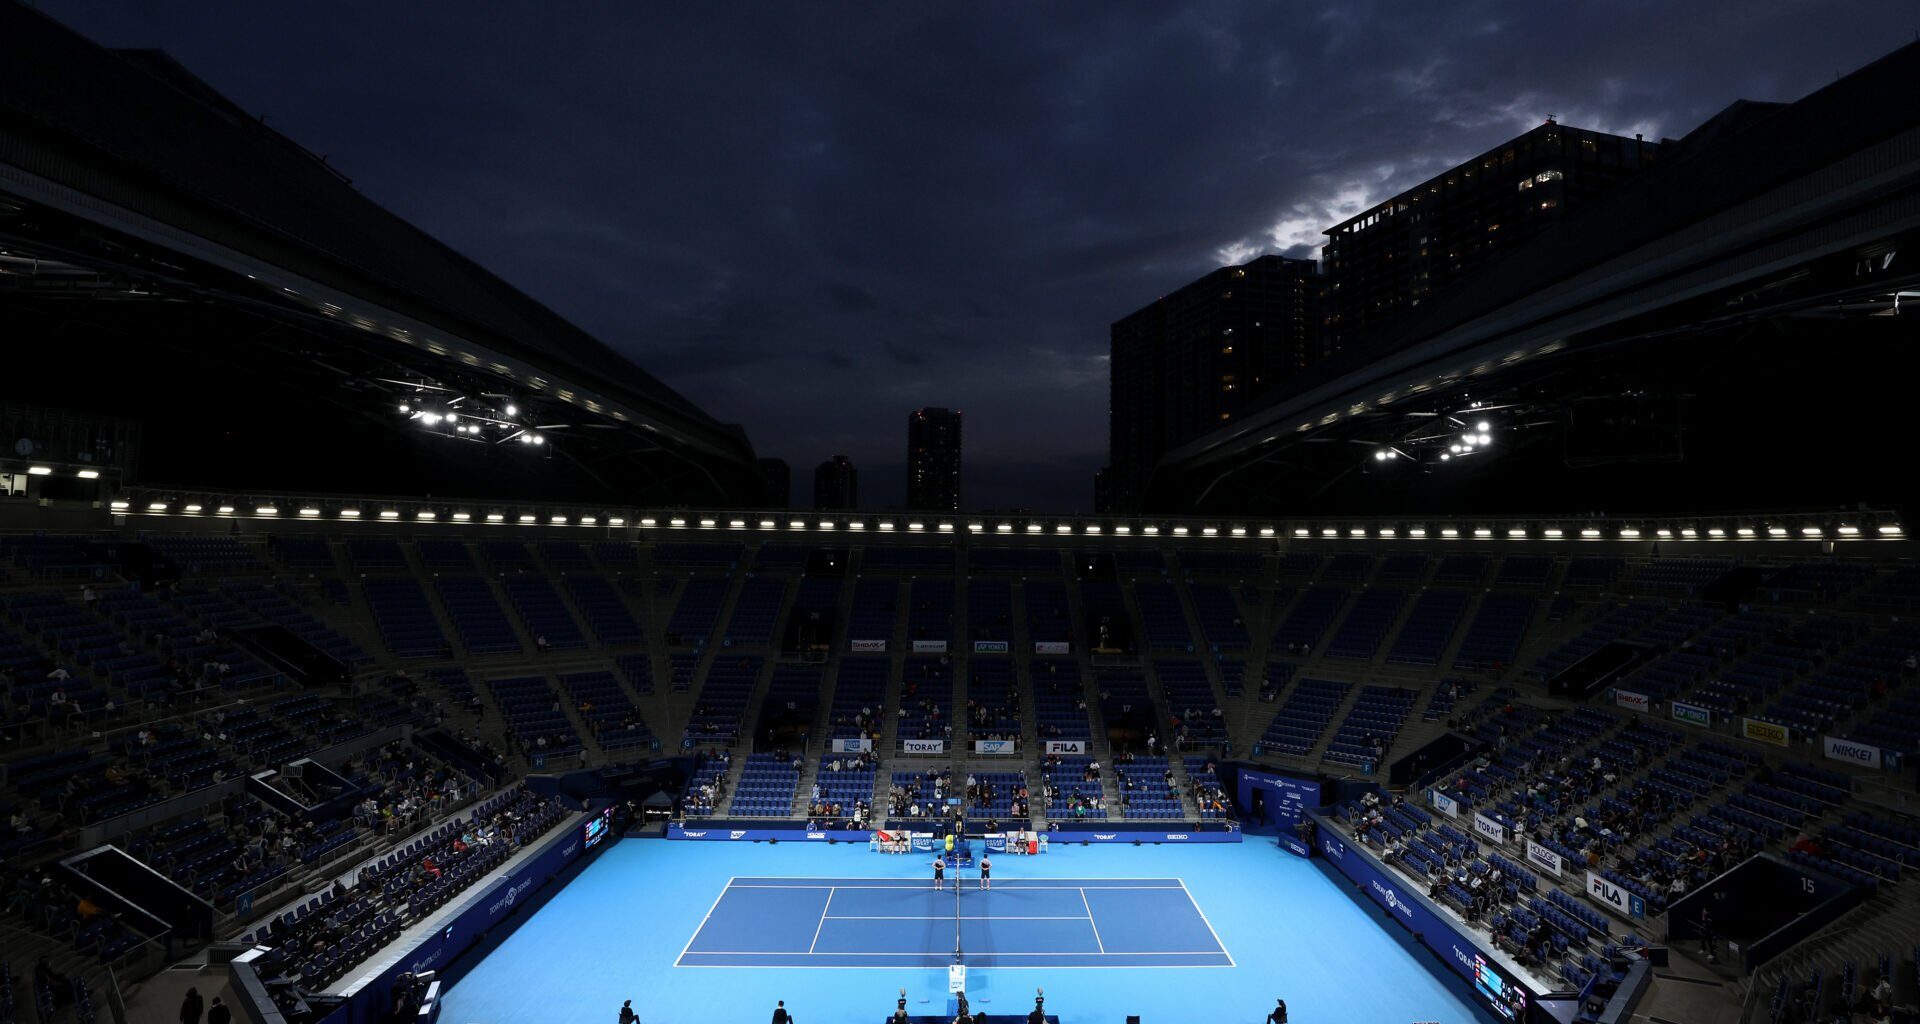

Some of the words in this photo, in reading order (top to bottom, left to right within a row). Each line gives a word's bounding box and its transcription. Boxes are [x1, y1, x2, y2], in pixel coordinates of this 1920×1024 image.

[787, 701, 796, 710] 18
[1747, 724, 1784, 741] SEIKO
[984, 744, 1000, 752] SAP
[1052, 744, 1078, 752] FILA
[1832, 744, 1872, 761] NIKKEI
[1530, 843, 1556, 864] HOLOGIC
[1372, 880, 1386, 896] TORAY
[1594, 879, 1622, 906] FILA
[1801, 877, 1815, 894] 15
